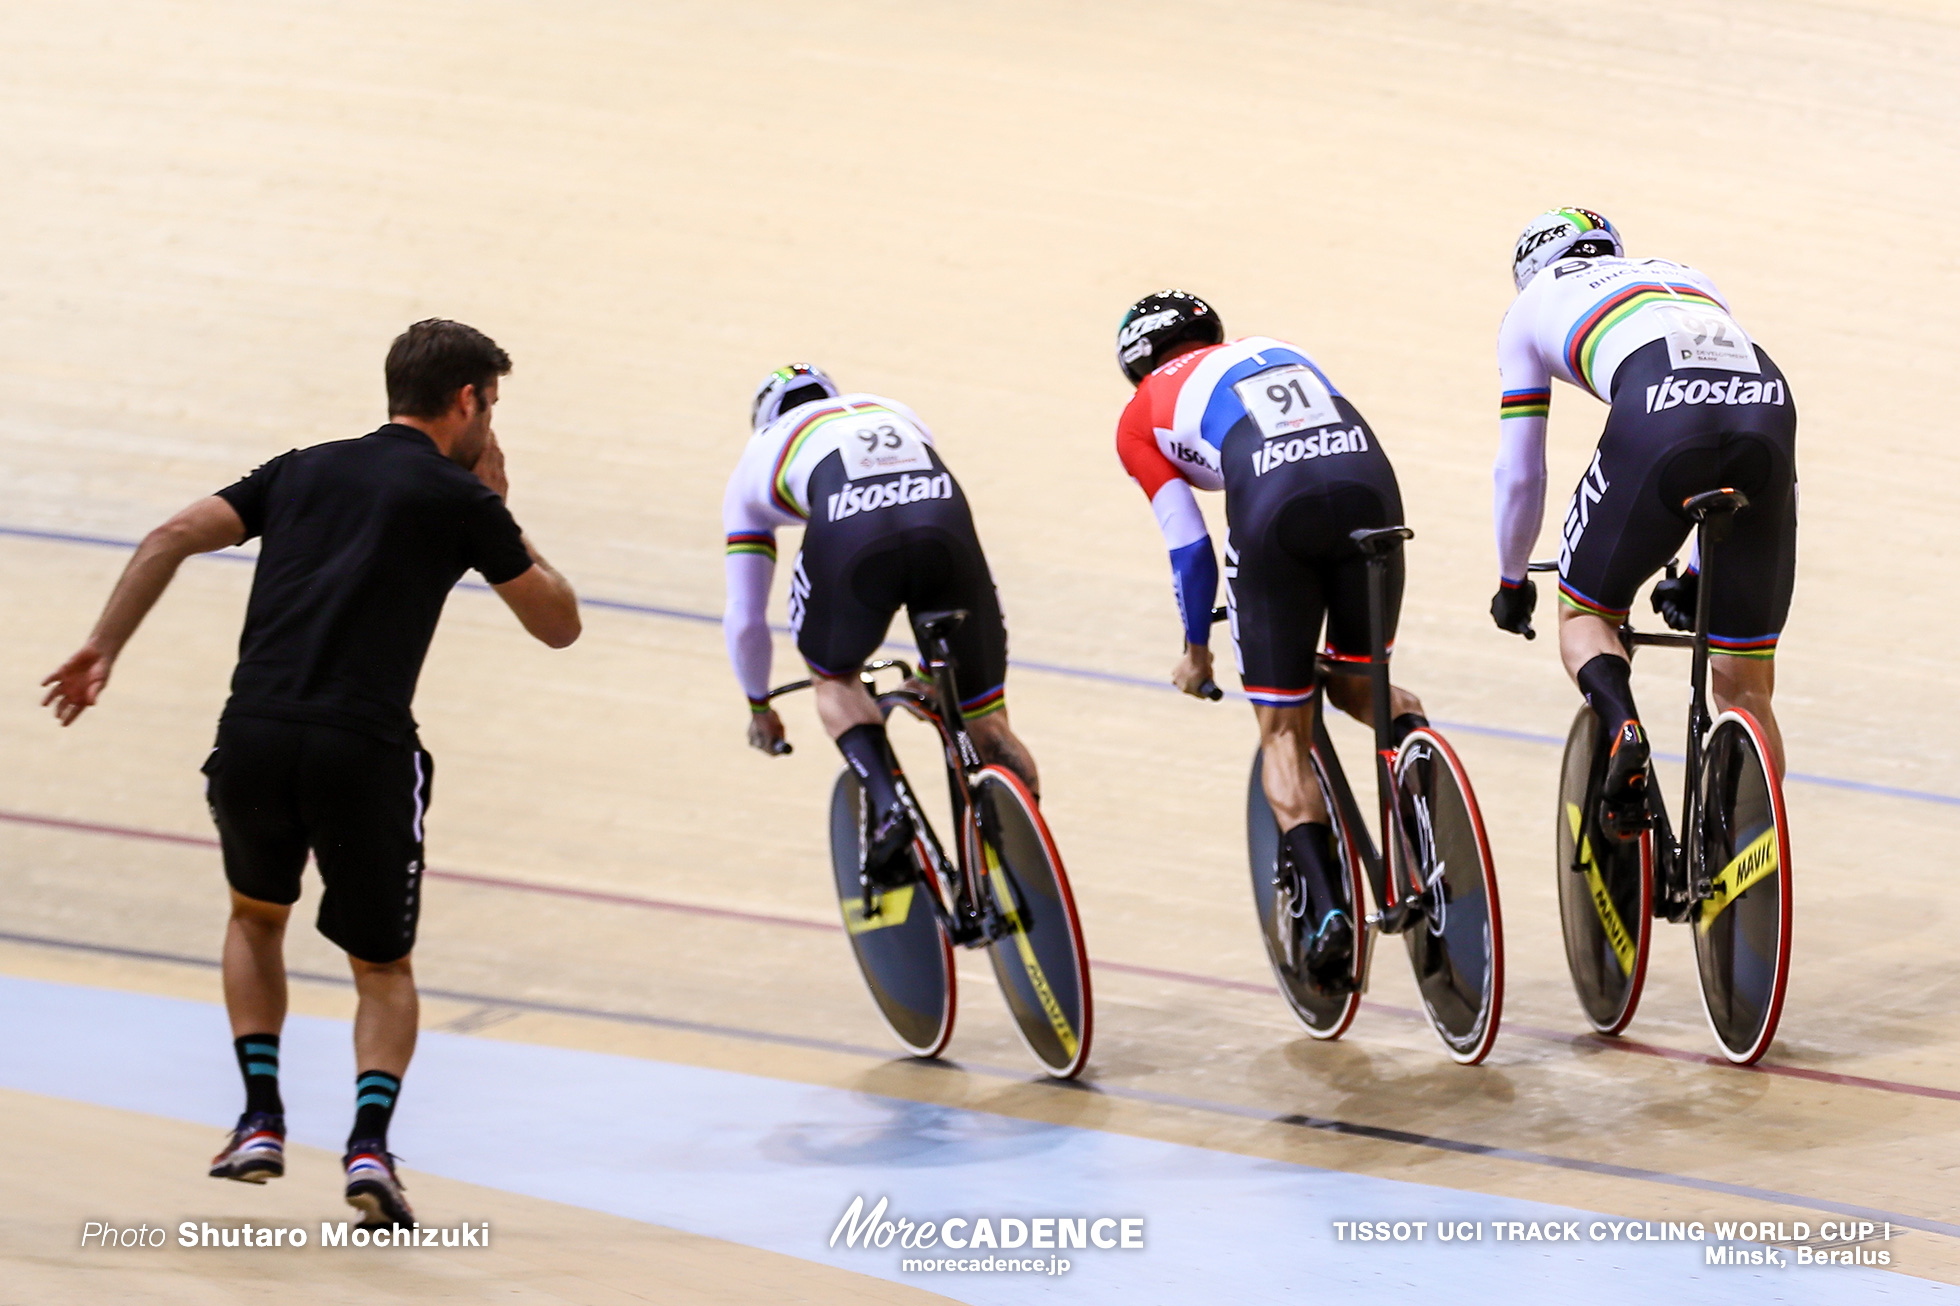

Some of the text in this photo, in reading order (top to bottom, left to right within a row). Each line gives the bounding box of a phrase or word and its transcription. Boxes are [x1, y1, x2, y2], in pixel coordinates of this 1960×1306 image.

[1682, 316, 1736, 348] 92
[1267, 379, 1311, 415] 91
[857, 425, 902, 454] 93
[1735, 840, 1773, 888] MAVIC
